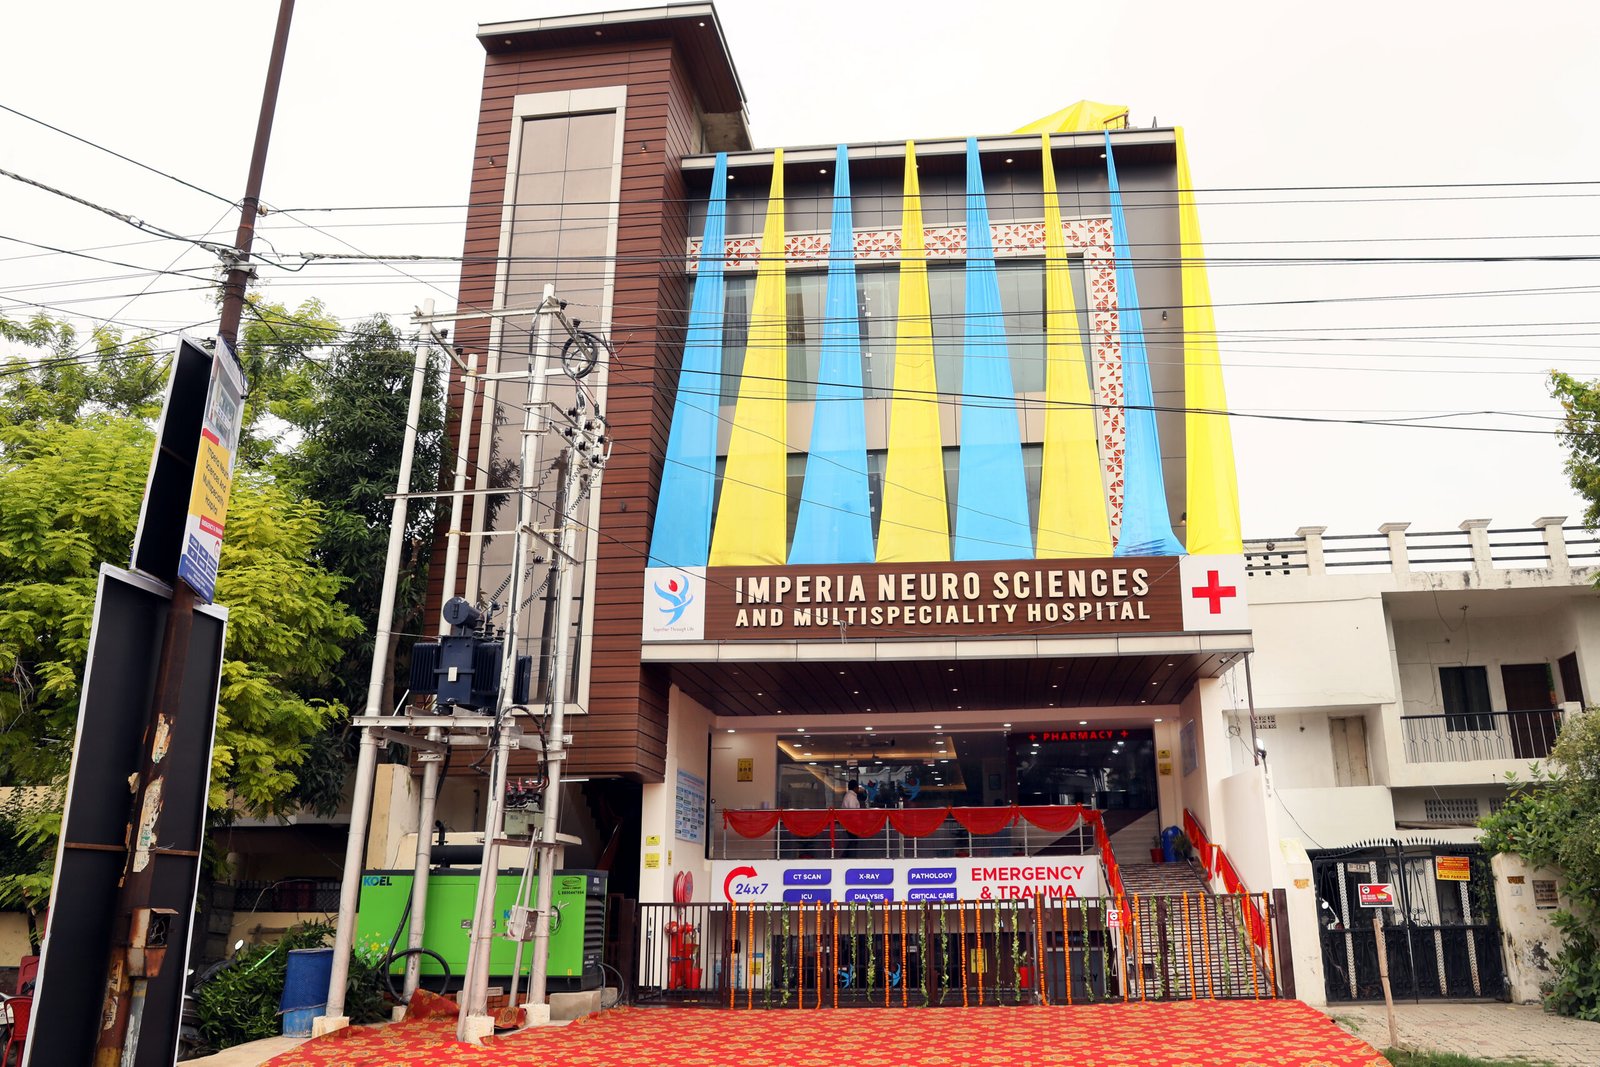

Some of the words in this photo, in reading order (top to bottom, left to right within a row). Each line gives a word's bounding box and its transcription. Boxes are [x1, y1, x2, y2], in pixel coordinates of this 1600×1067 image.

[735, 575, 866, 604] IMPERIA
[878, 572, 981, 602] NEURO
[992, 568, 1150, 600] SCIENCES
[735, 608, 784, 627] AND
[793, 603, 1018, 627] MULTISPECIALITY
[1027, 601, 1151, 623] HOSPITAL
[1043, 731, 1113, 740] PHARMACY
[971, 866, 1085, 881] EMERGENCY
[364, 876, 393, 886] KOEL
[735, 883, 769, 895] 24x7
[980, 886, 992, 899] &
[997, 885, 1077, 899] TRAUMA
